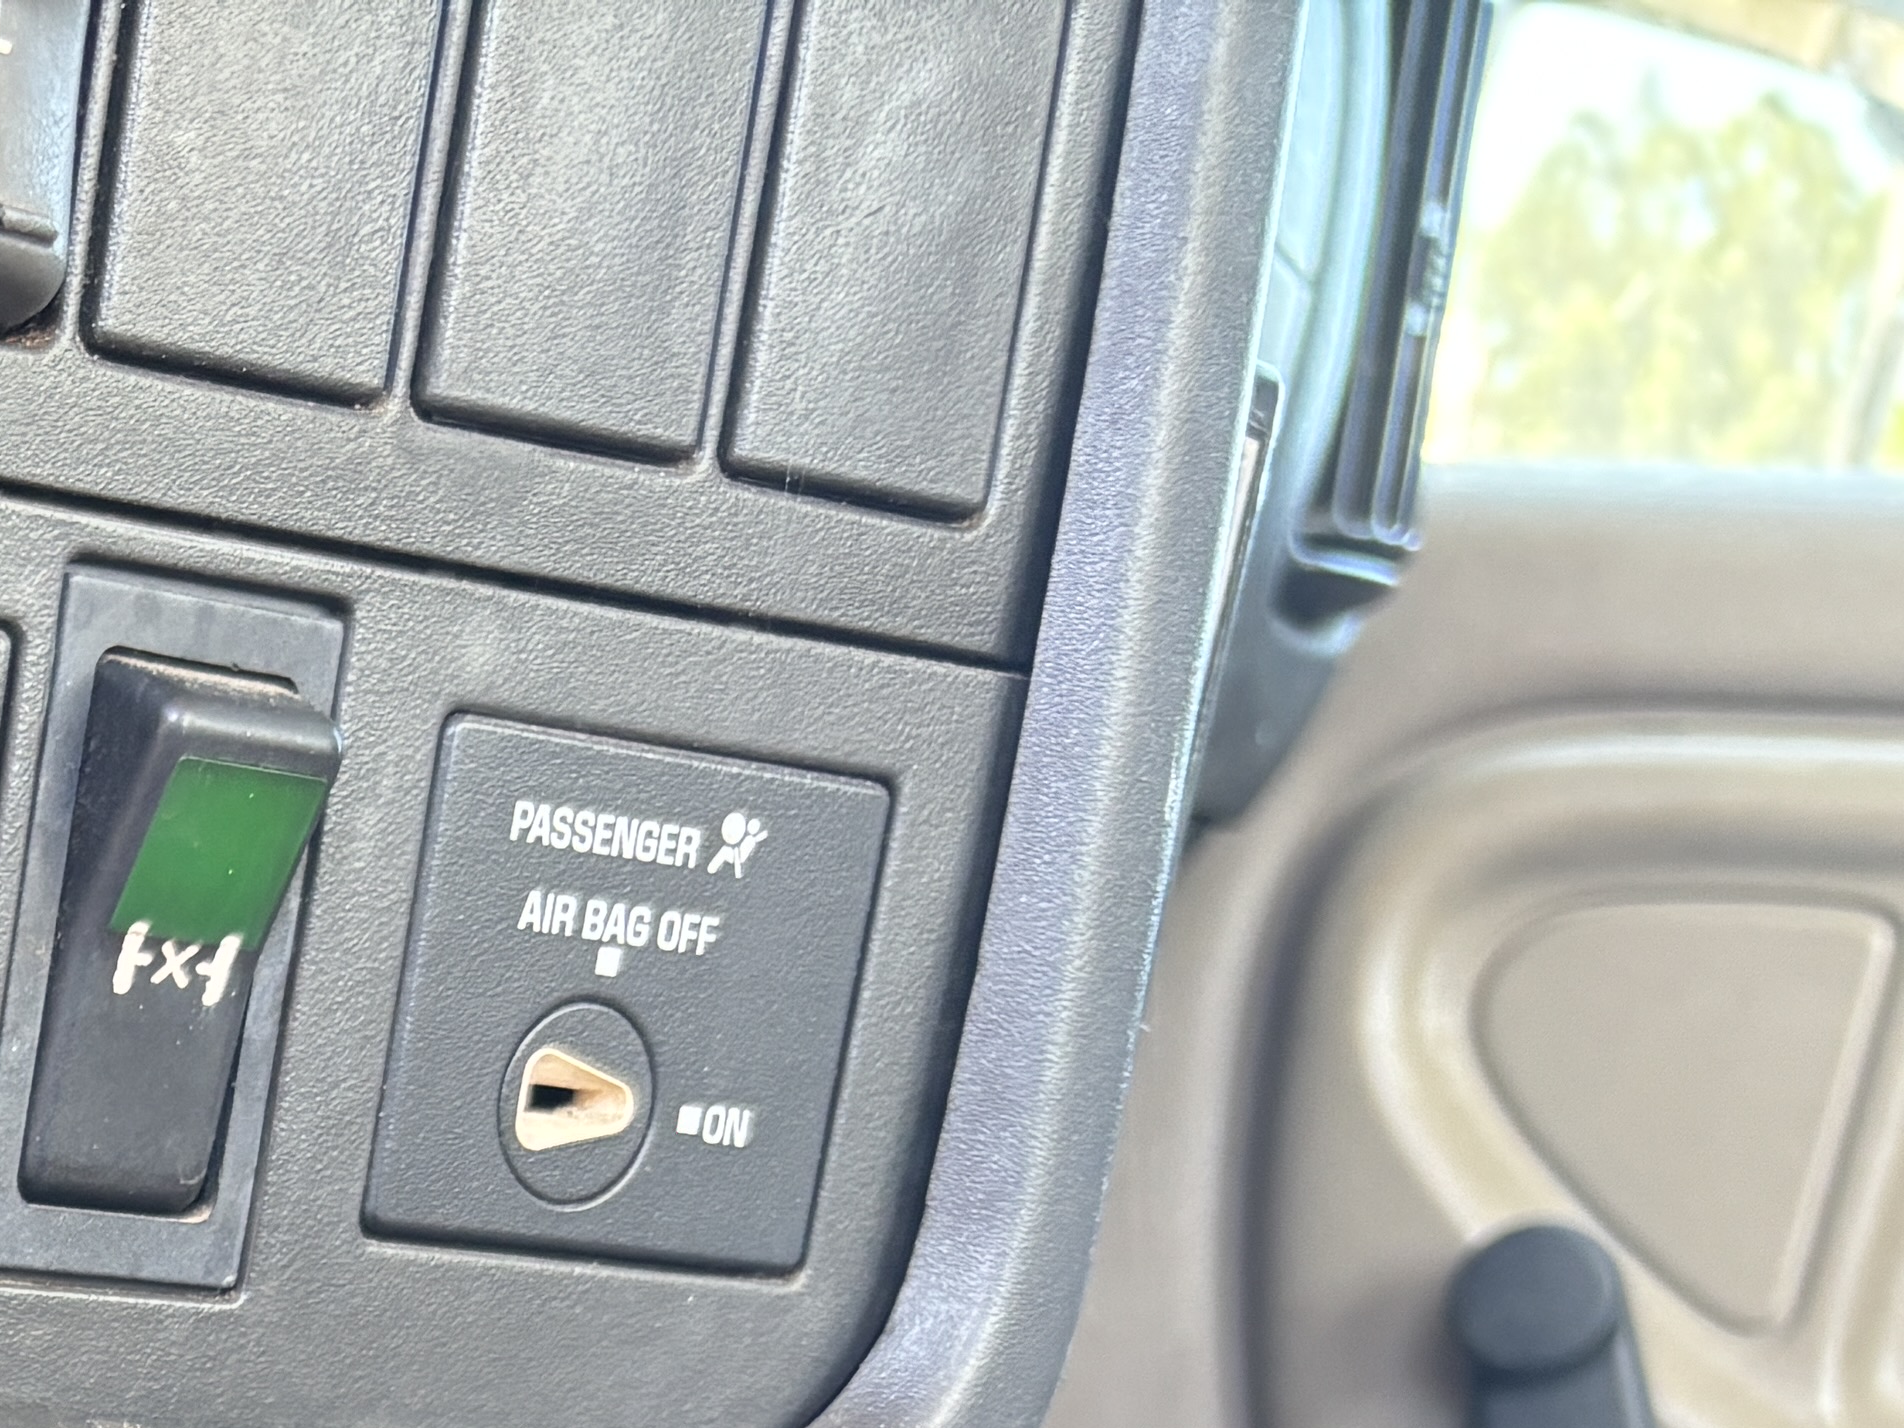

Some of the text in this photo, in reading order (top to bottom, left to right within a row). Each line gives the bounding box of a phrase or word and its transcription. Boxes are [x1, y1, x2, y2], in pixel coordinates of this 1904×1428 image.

[509, 800, 701, 869] PASSENGER
[517, 890, 720, 956] AIR BAG OFF
[702, 1105, 752, 1148] ON
